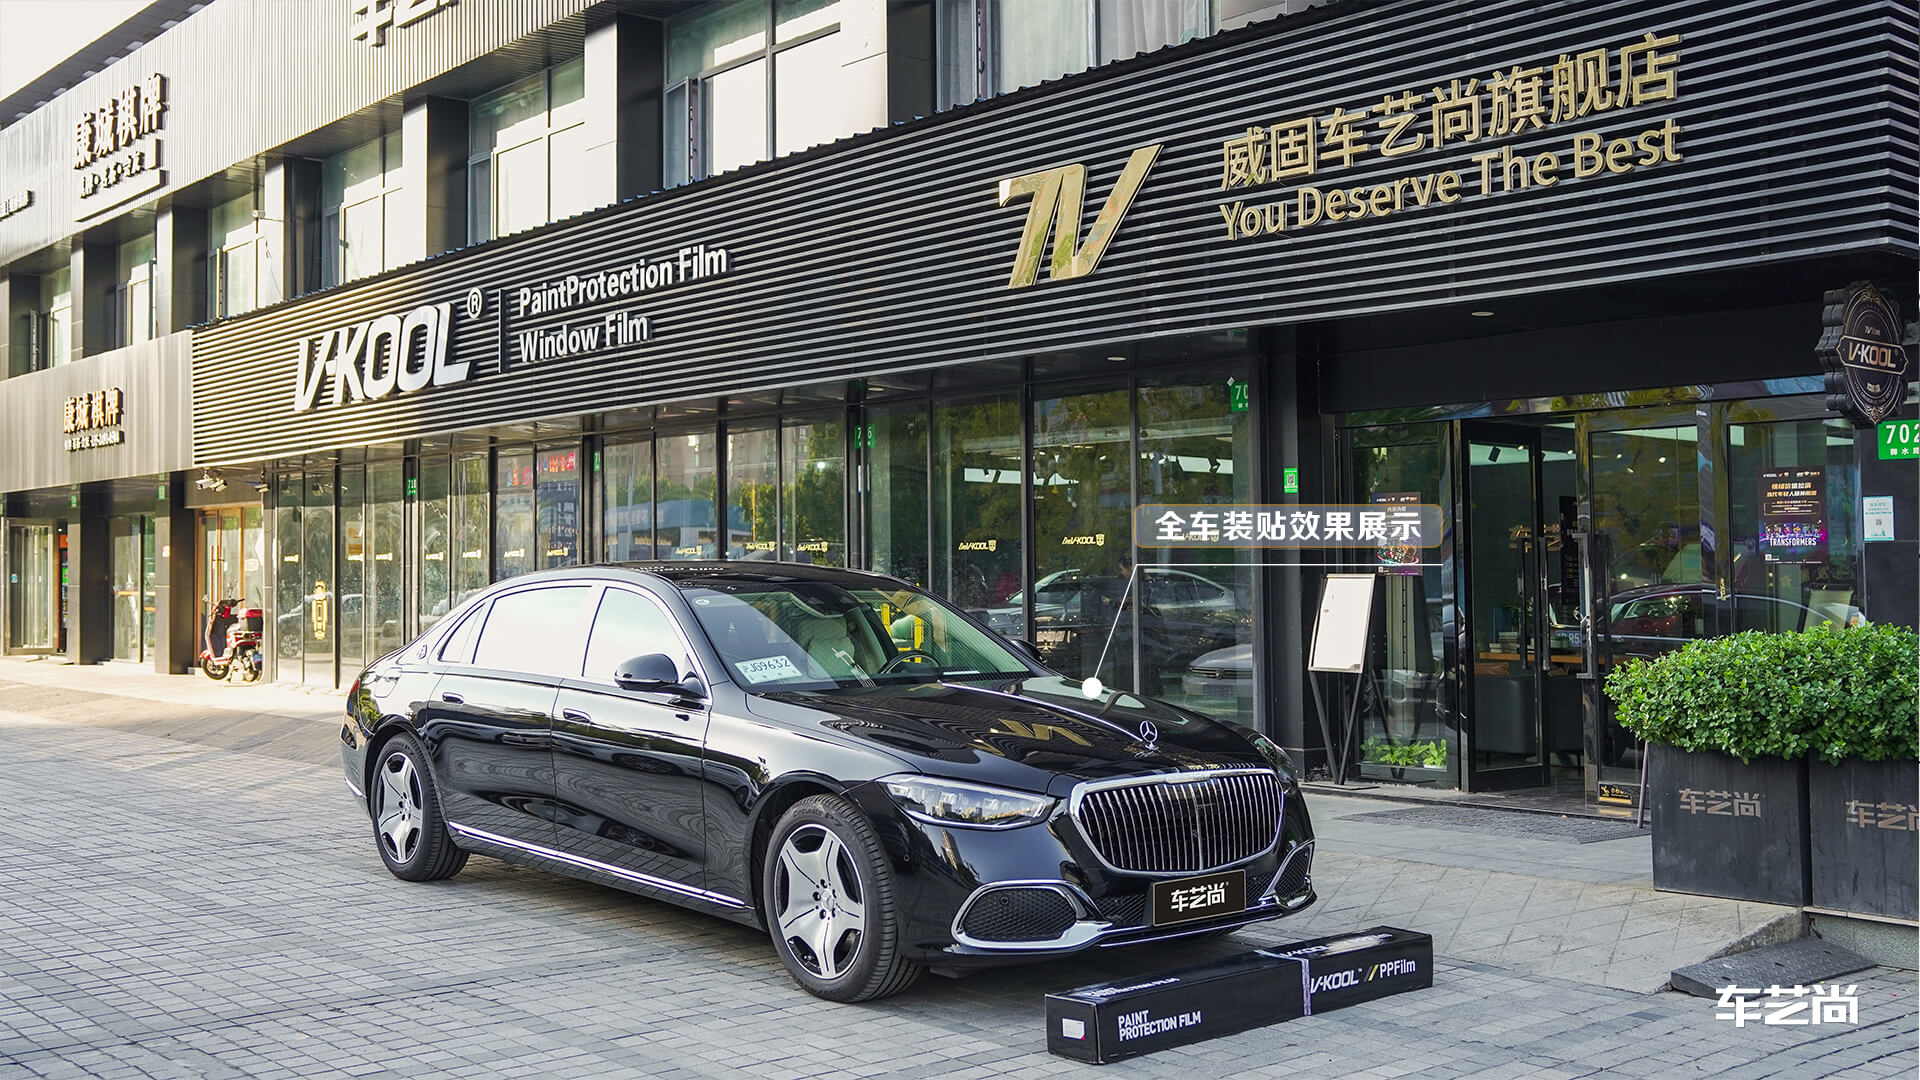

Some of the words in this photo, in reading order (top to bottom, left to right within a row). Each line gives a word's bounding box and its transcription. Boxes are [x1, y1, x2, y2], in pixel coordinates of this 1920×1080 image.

[1221, 31, 1682, 191] 威固车艺尚旗舰店
[1219, 201, 1287, 240] You
[1297, 170, 1461, 228] Deserve
[1471, 146, 1560, 197] The
[1573, 118, 1684, 181] Best
[519, 257, 673, 318] PaintProtection
[679, 244, 728, 281] Film
[293, 302, 471, 412] V-KOOL
[519, 322, 601, 363] Window
[605, 312, 649, 346] Film
[64, 387, 121, 433] 康城棋牌
[1769, 537, 1817, 547] TRANSFORMERS
[1679, 788, 1761, 818] 车艺尚
[1170, 881, 1225, 912] 车艺尚
[1379, 959, 1416, 979] PPFilm
[1117, 1009, 1149, 1029] PAINT
[1119, 1018, 1178, 1042] PROTECTION
[1178, 1010, 1202, 1028] FILM
